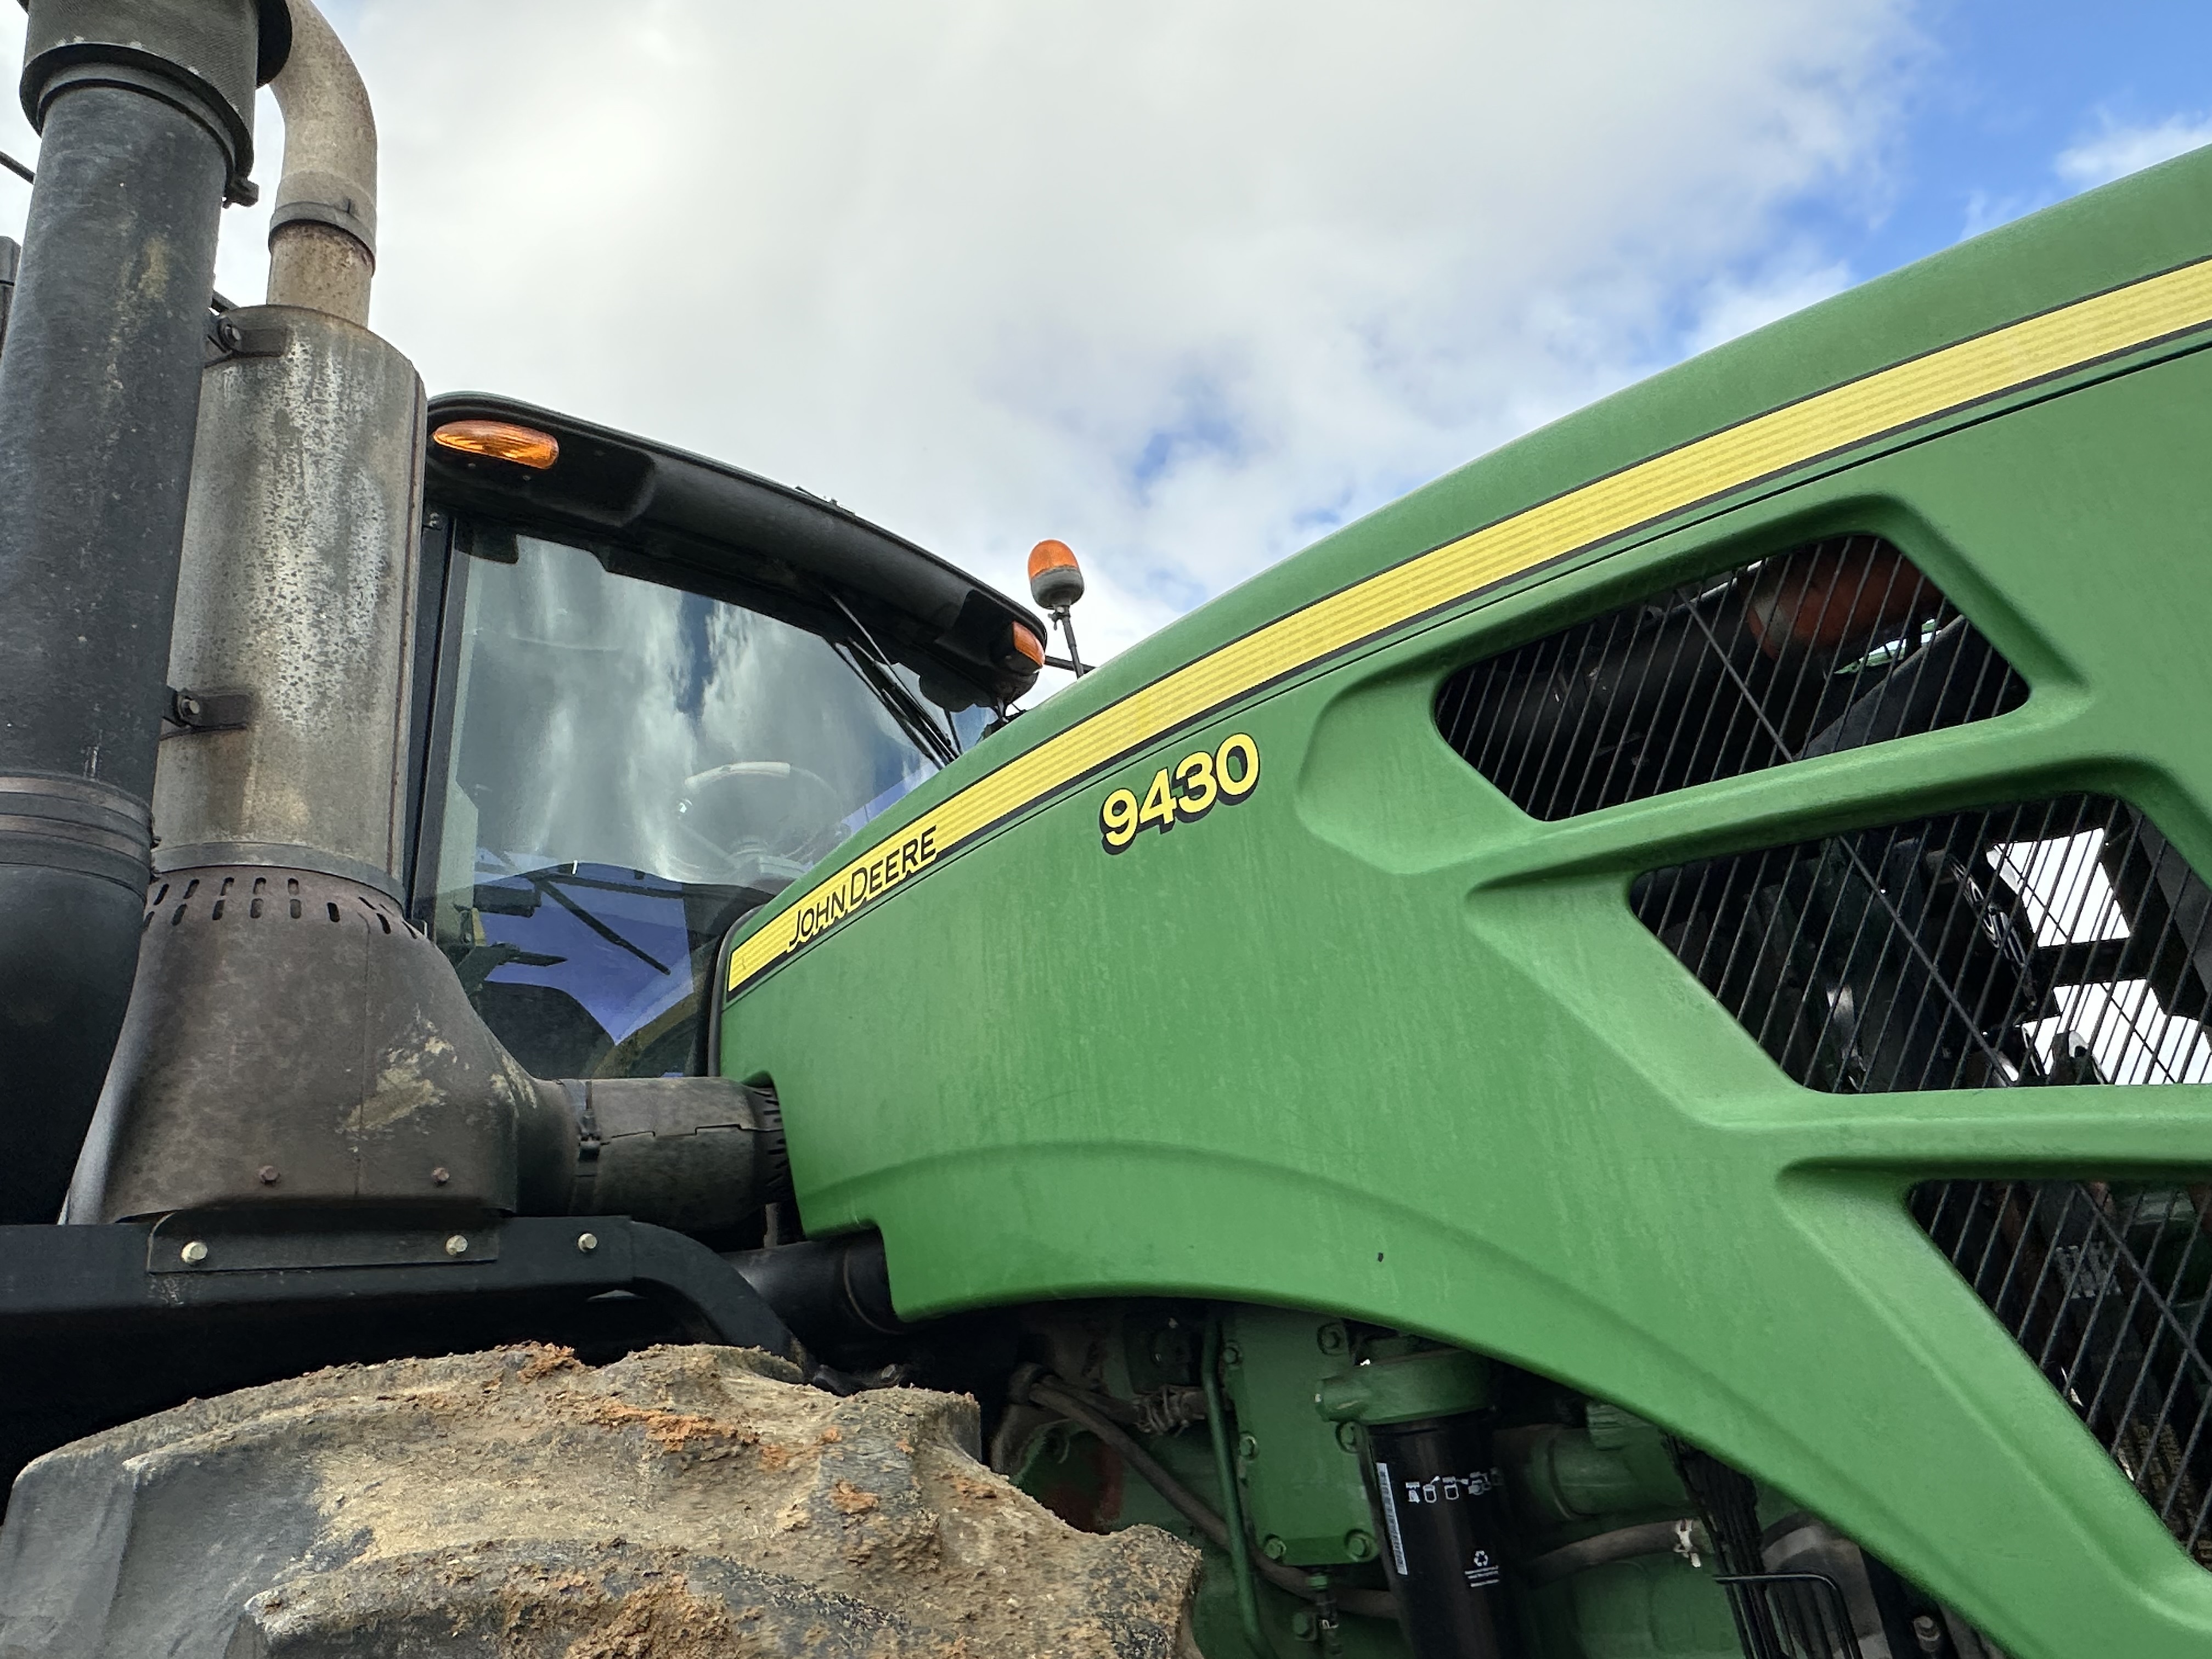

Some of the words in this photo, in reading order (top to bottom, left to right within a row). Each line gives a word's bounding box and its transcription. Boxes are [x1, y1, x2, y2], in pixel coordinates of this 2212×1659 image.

[1099, 732, 1260, 855] 9430
[788, 884, 847, 947] JOHN
[850, 825, 937, 907] DEERE
